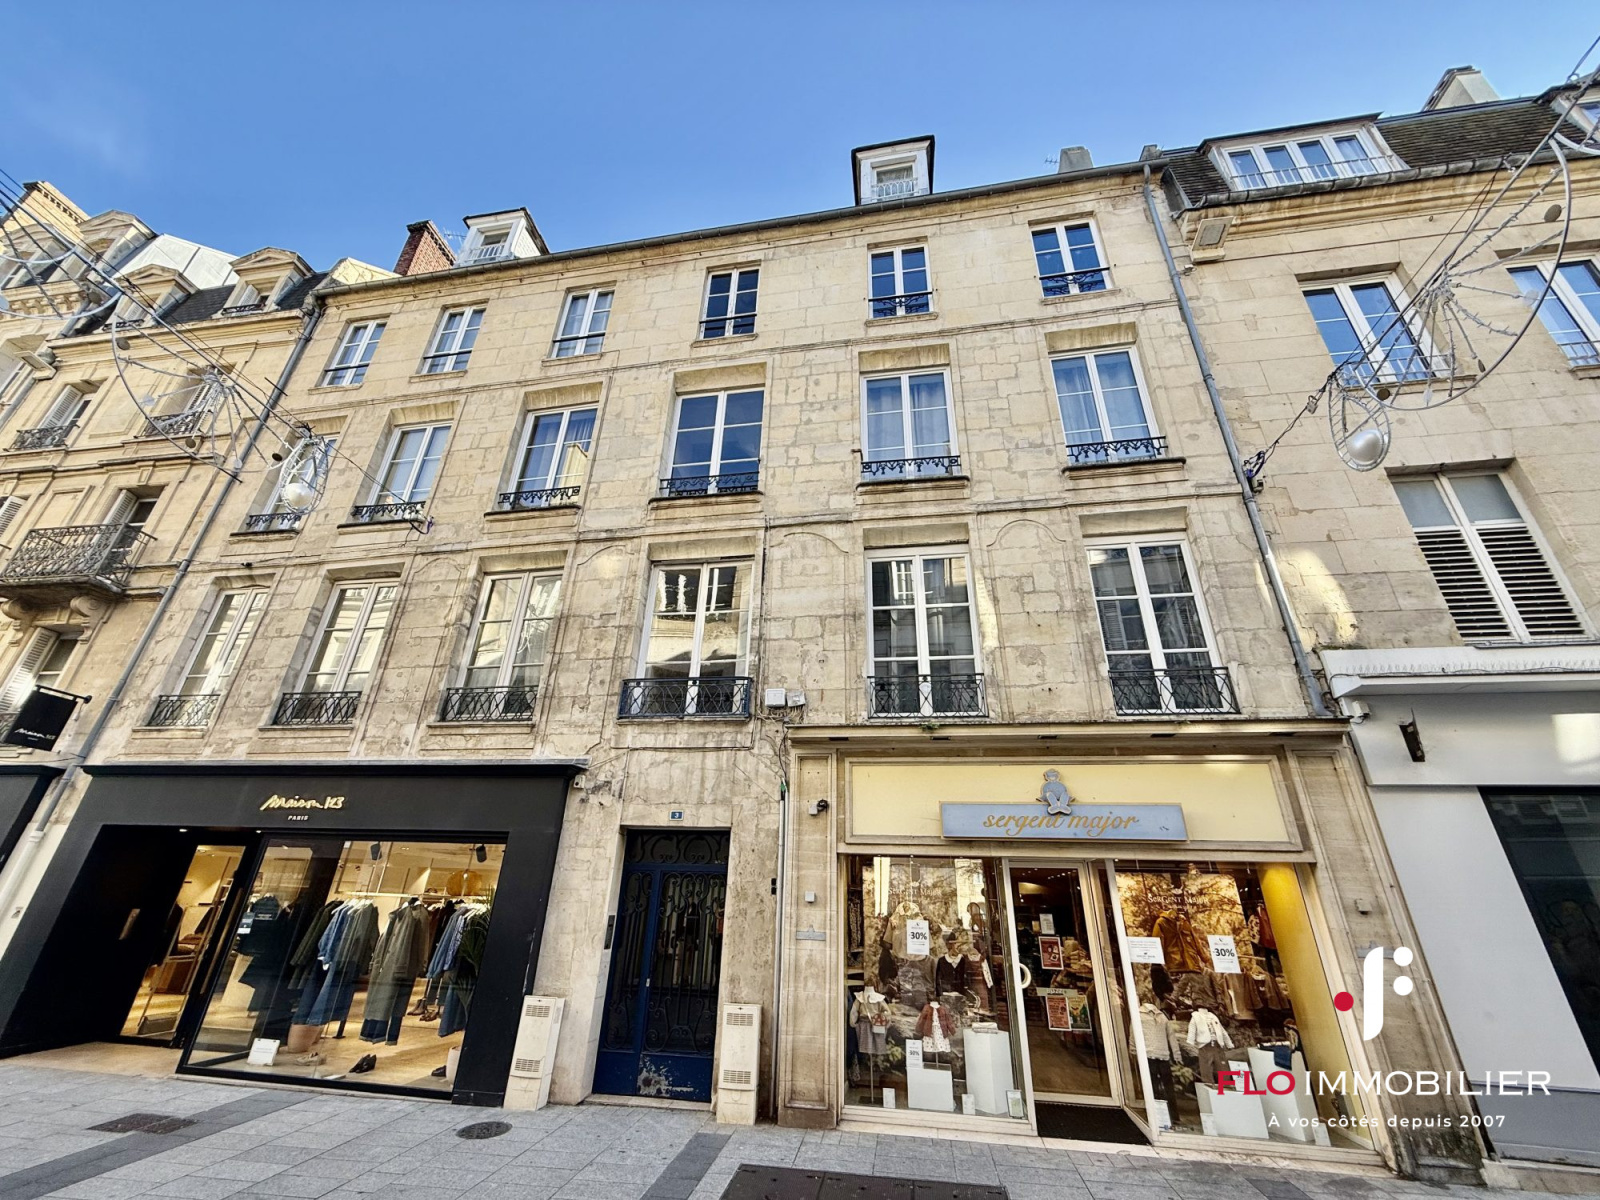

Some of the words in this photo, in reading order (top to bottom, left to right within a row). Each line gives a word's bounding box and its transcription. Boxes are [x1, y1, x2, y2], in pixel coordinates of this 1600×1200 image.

[260, 795, 323, 810] Maison
[983, 814, 1066, 836] sergent
[1067, 812, 1140, 837] major
